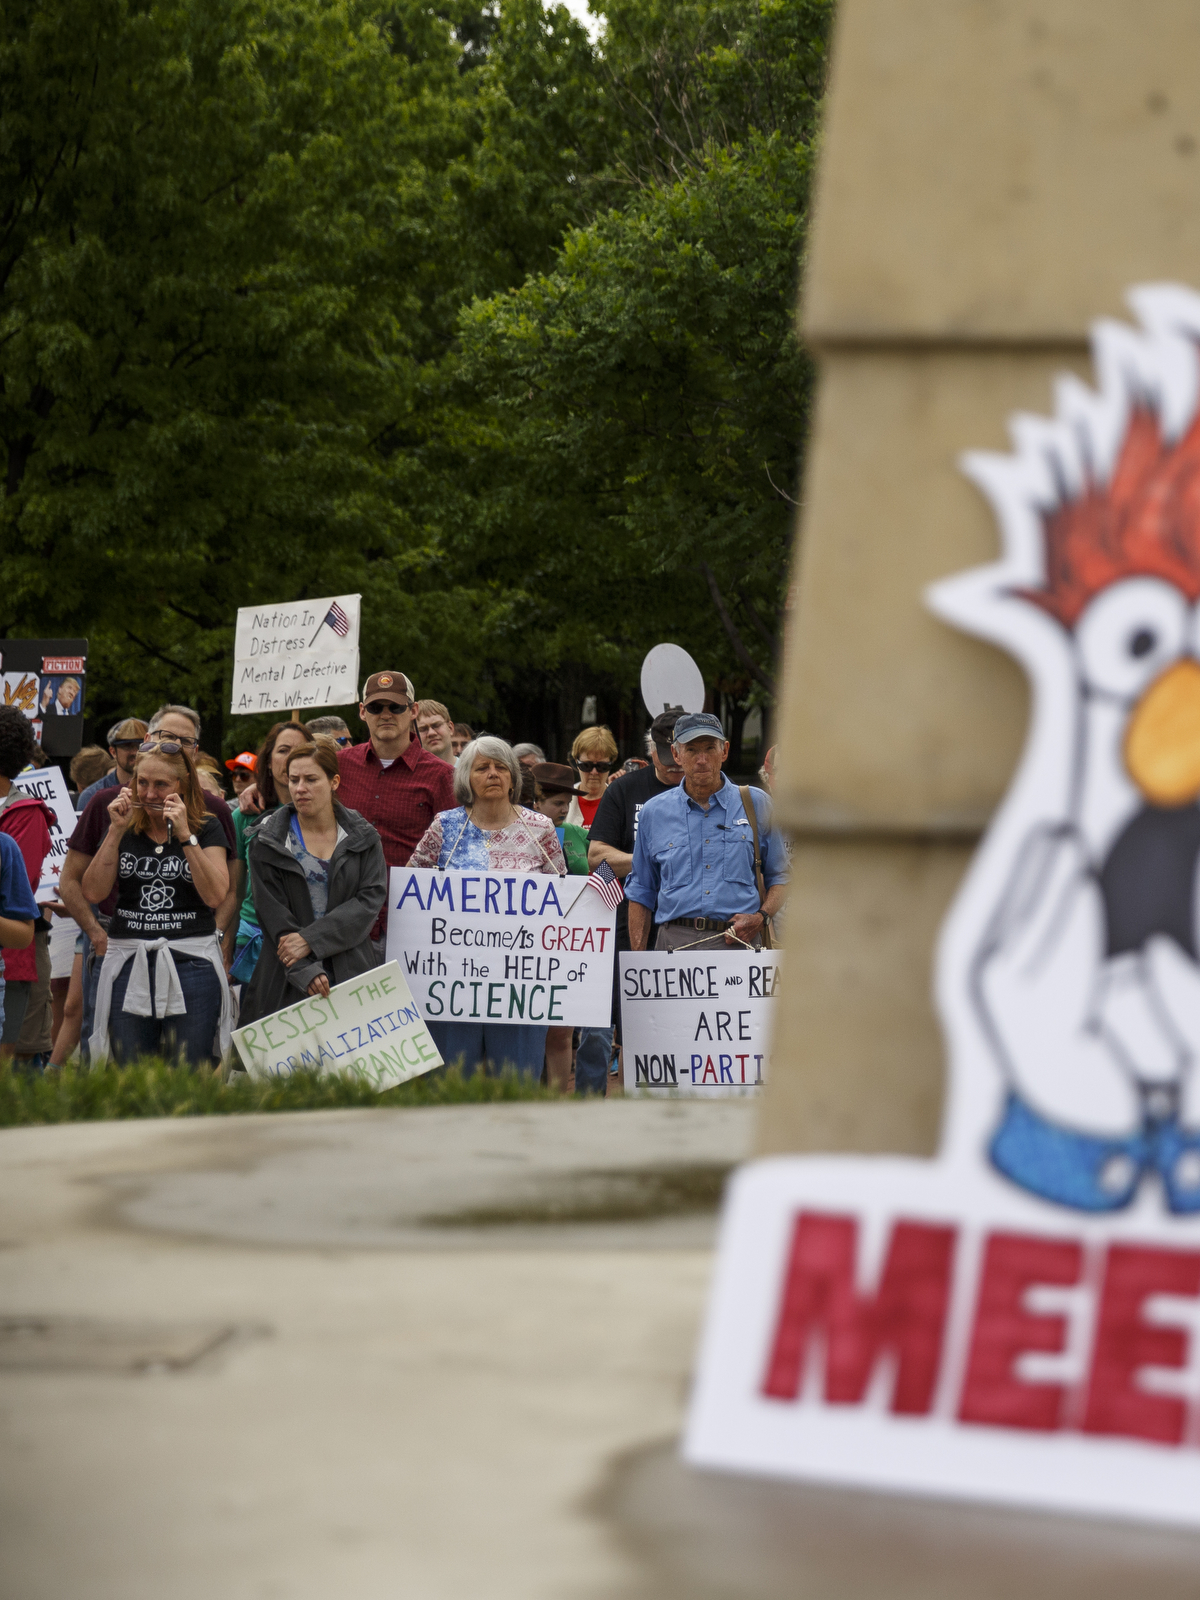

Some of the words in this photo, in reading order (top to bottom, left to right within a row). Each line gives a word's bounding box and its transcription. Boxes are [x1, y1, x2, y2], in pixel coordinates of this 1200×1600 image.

[252, 611, 298, 630] Nation
[301, 610, 315, 627] In
[250, 637, 305, 657] Distress
[46, 660, 81, 671] FICTION
[241, 665, 286, 684] Mental
[293, 661, 347, 680] Defective
[238, 693, 253, 709] At
[259, 692, 280, 709] The
[285, 688, 320, 708] Wheel
[396, 873, 563, 916] AMERICA
[127, 920, 142, 930] YOU
[144, 921, 182, 931] BELIEVE
[145, 913, 171, 922] CARE
[171, 911, 197, 920] WHAT
[541, 925, 611, 953] GREAT
[404, 950, 447, 976] With
[462, 957, 490, 978] the
[504, 955, 560, 981] HELP
[567, 962, 588, 982] of
[624, 966, 719, 998] SCIENCE
[724, 975, 743, 986] AND
[426, 980, 568, 1021] SCIENCE
[240, 987, 340, 1059] RESIST
[348, 975, 397, 1006] THE
[694, 1010, 752, 1042] ARE
